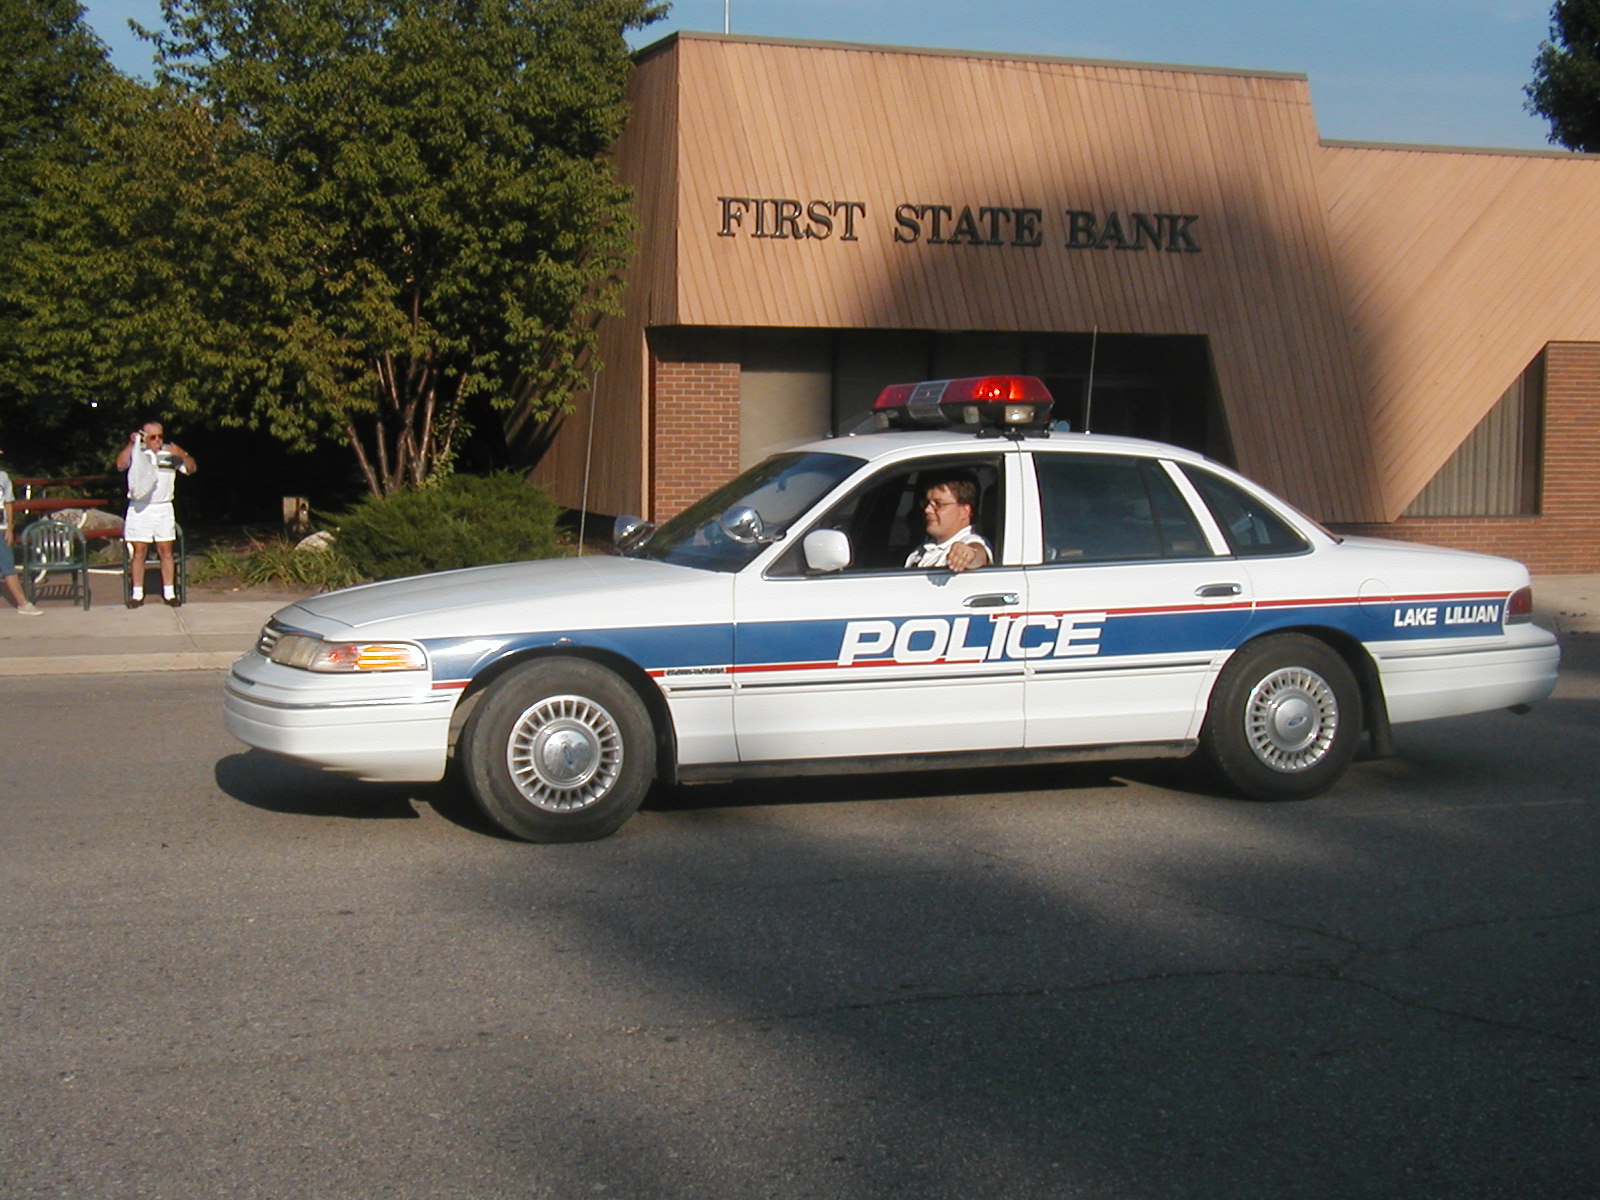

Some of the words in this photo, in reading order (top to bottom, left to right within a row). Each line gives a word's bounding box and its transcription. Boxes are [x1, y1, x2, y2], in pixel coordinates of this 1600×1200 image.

[717, 197, 865, 241] FIRST
[894, 204, 1042, 247] STATE
[1065, 210, 1200, 253] BANK
[837, 612, 1107, 666] POLICE
[1394, 607, 1438, 627] LAKE
[1444, 604, 1499, 624] LILLIAN
